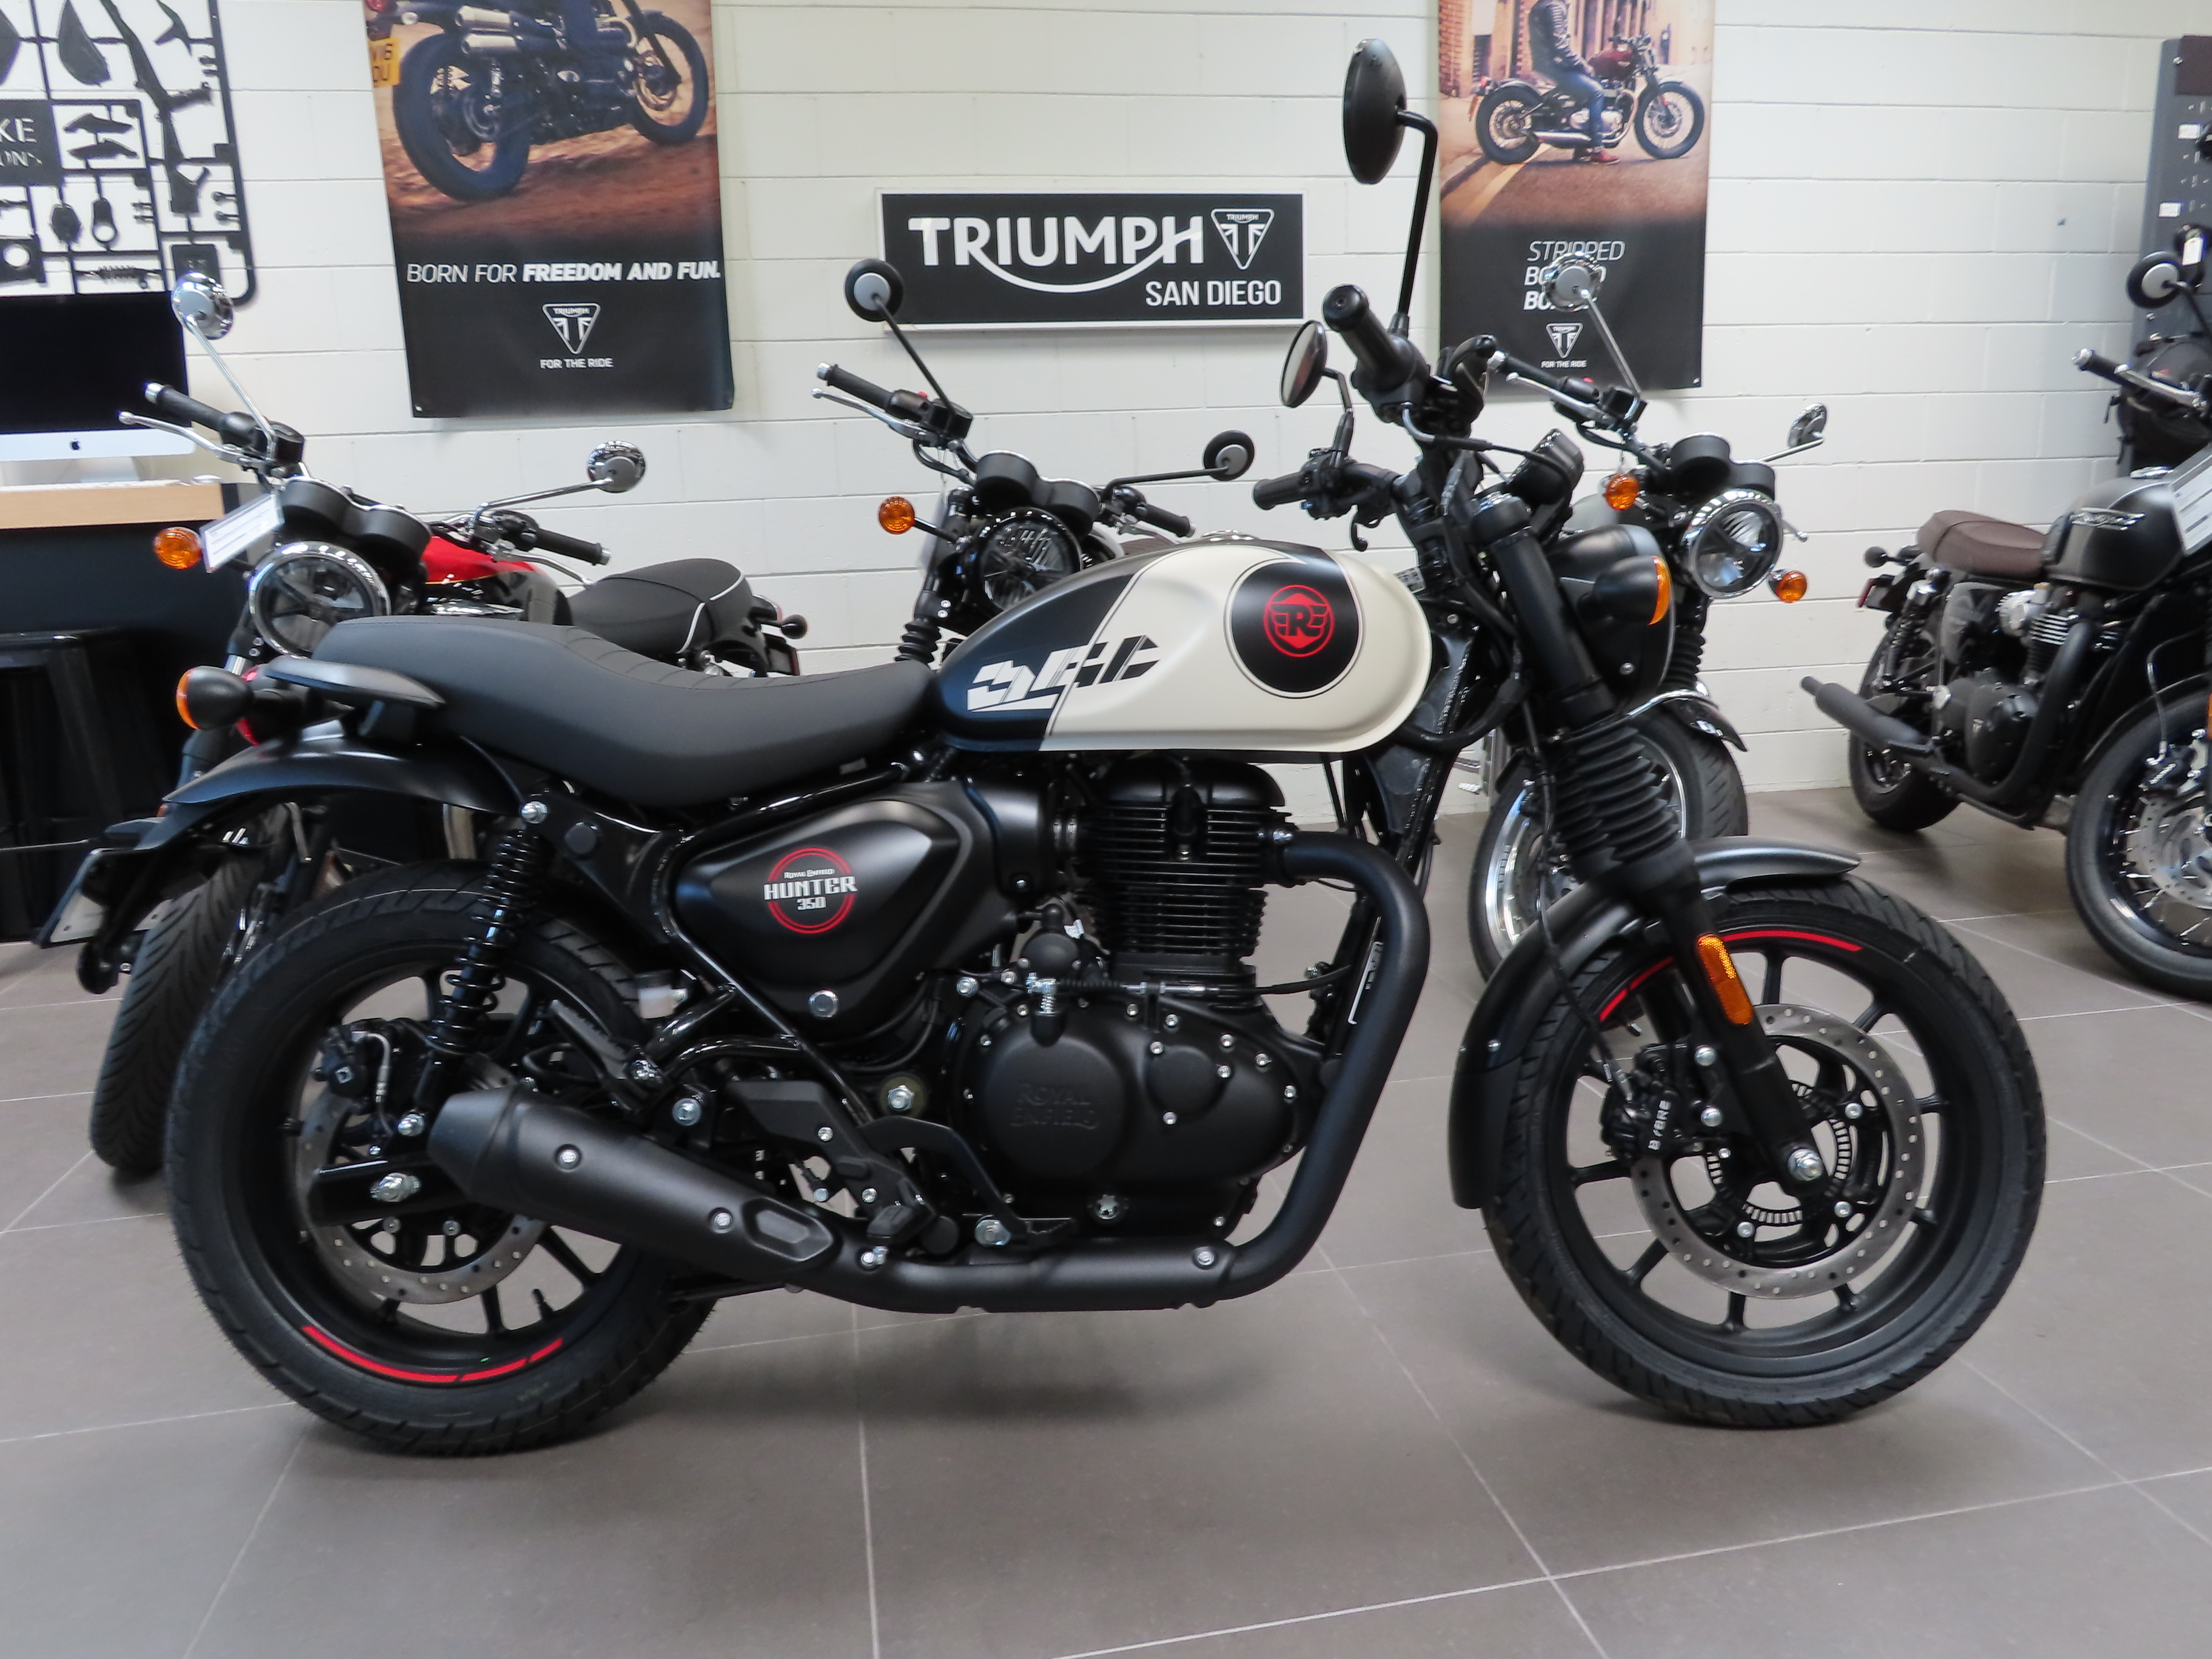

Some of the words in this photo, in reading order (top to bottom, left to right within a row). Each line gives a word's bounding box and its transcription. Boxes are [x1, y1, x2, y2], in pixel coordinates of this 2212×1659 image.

[1226, 213, 1259, 223] TRIUMPH
[908, 216, 1204, 293] TRIUMPH
[407, 263, 468, 284] BORN
[475, 264, 517, 283] FOR
[522, 262, 623, 282] FREEDOM
[626, 262, 673, 281] AND
[676, 260, 721, 280] FUN.
[1145, 280, 1200, 306] SAN
[1207, 280, 1282, 306] DIEGO
[540, 359, 563, 369] FOR
[563, 359, 586, 369] THE
[588, 357, 614, 368] RIDE
[763, 876, 858, 900] HUNTER
[796, 896, 827, 911] 350
